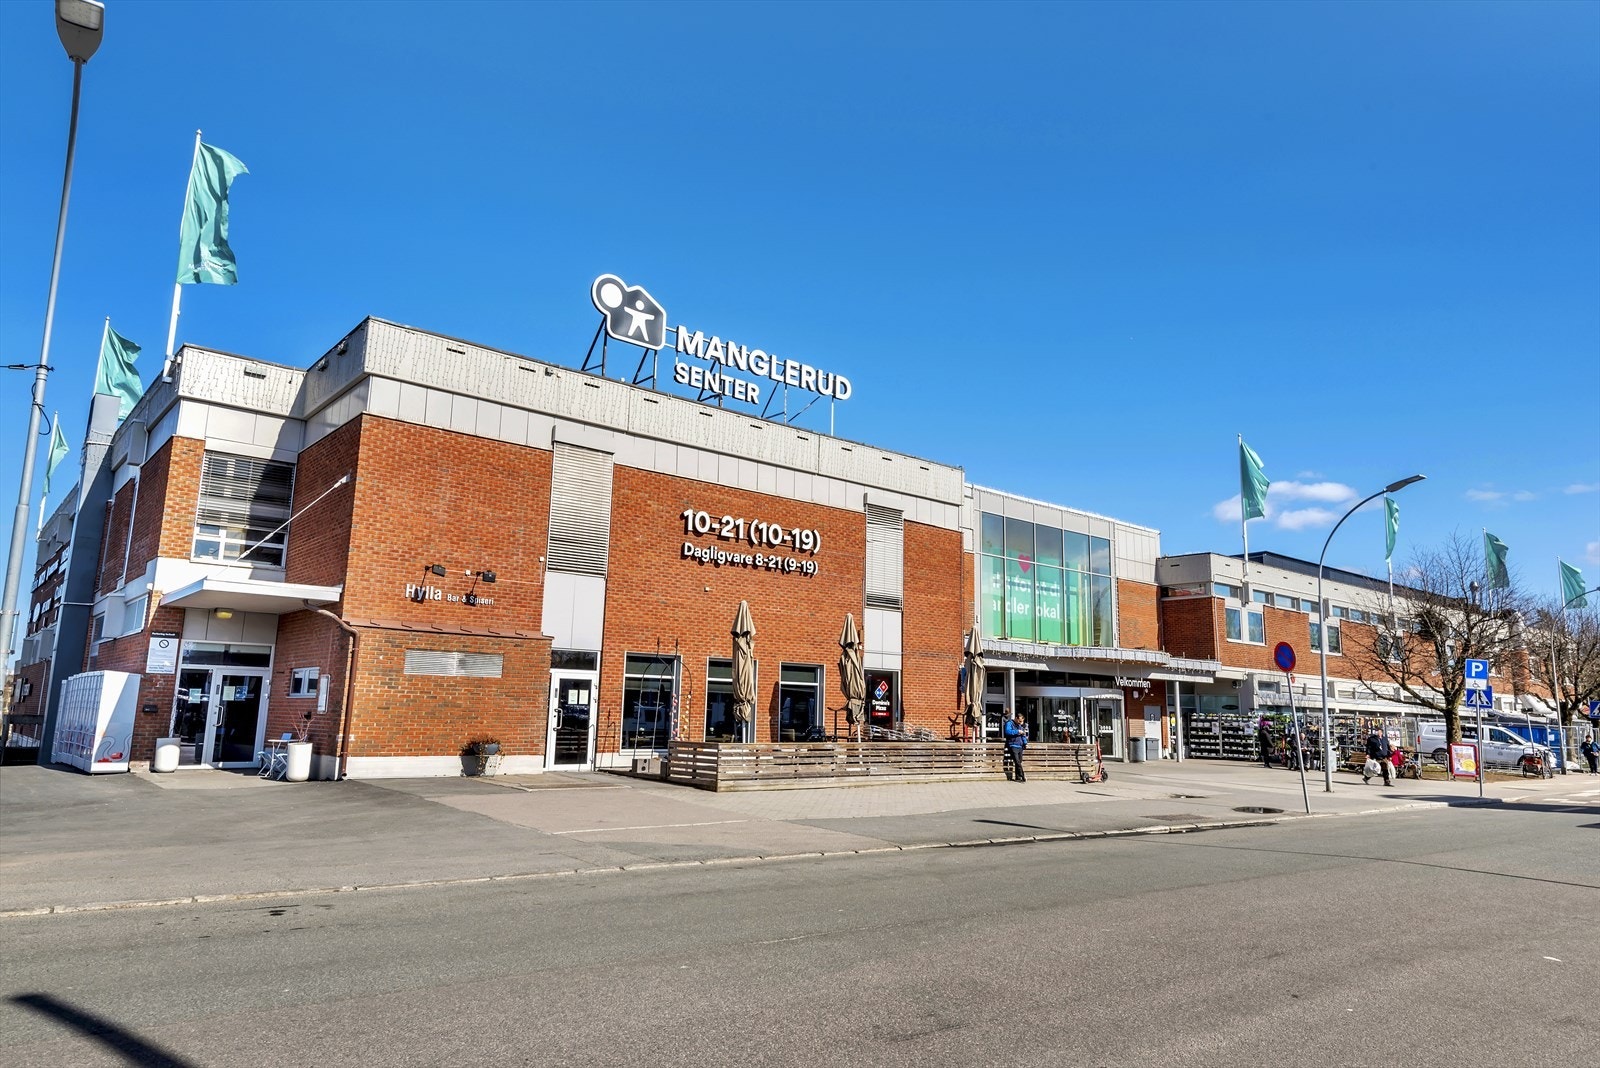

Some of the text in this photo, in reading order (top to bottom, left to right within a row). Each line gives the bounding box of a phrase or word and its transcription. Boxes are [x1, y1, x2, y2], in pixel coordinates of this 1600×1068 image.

[675, 325, 852, 401] MANGLERUD
[674, 362, 760, 404] SENTER
[682, 508, 821, 555] 10-21 (10-19)
[683, 542, 819, 576] Dagligvare 8-21 (9-19)
[405, 583, 442, 601] Hylla
[447, 593, 460, 602] Bar
[1114, 675, 1151, 689] Velkommen
[1471, 662, 1484, 677] P
